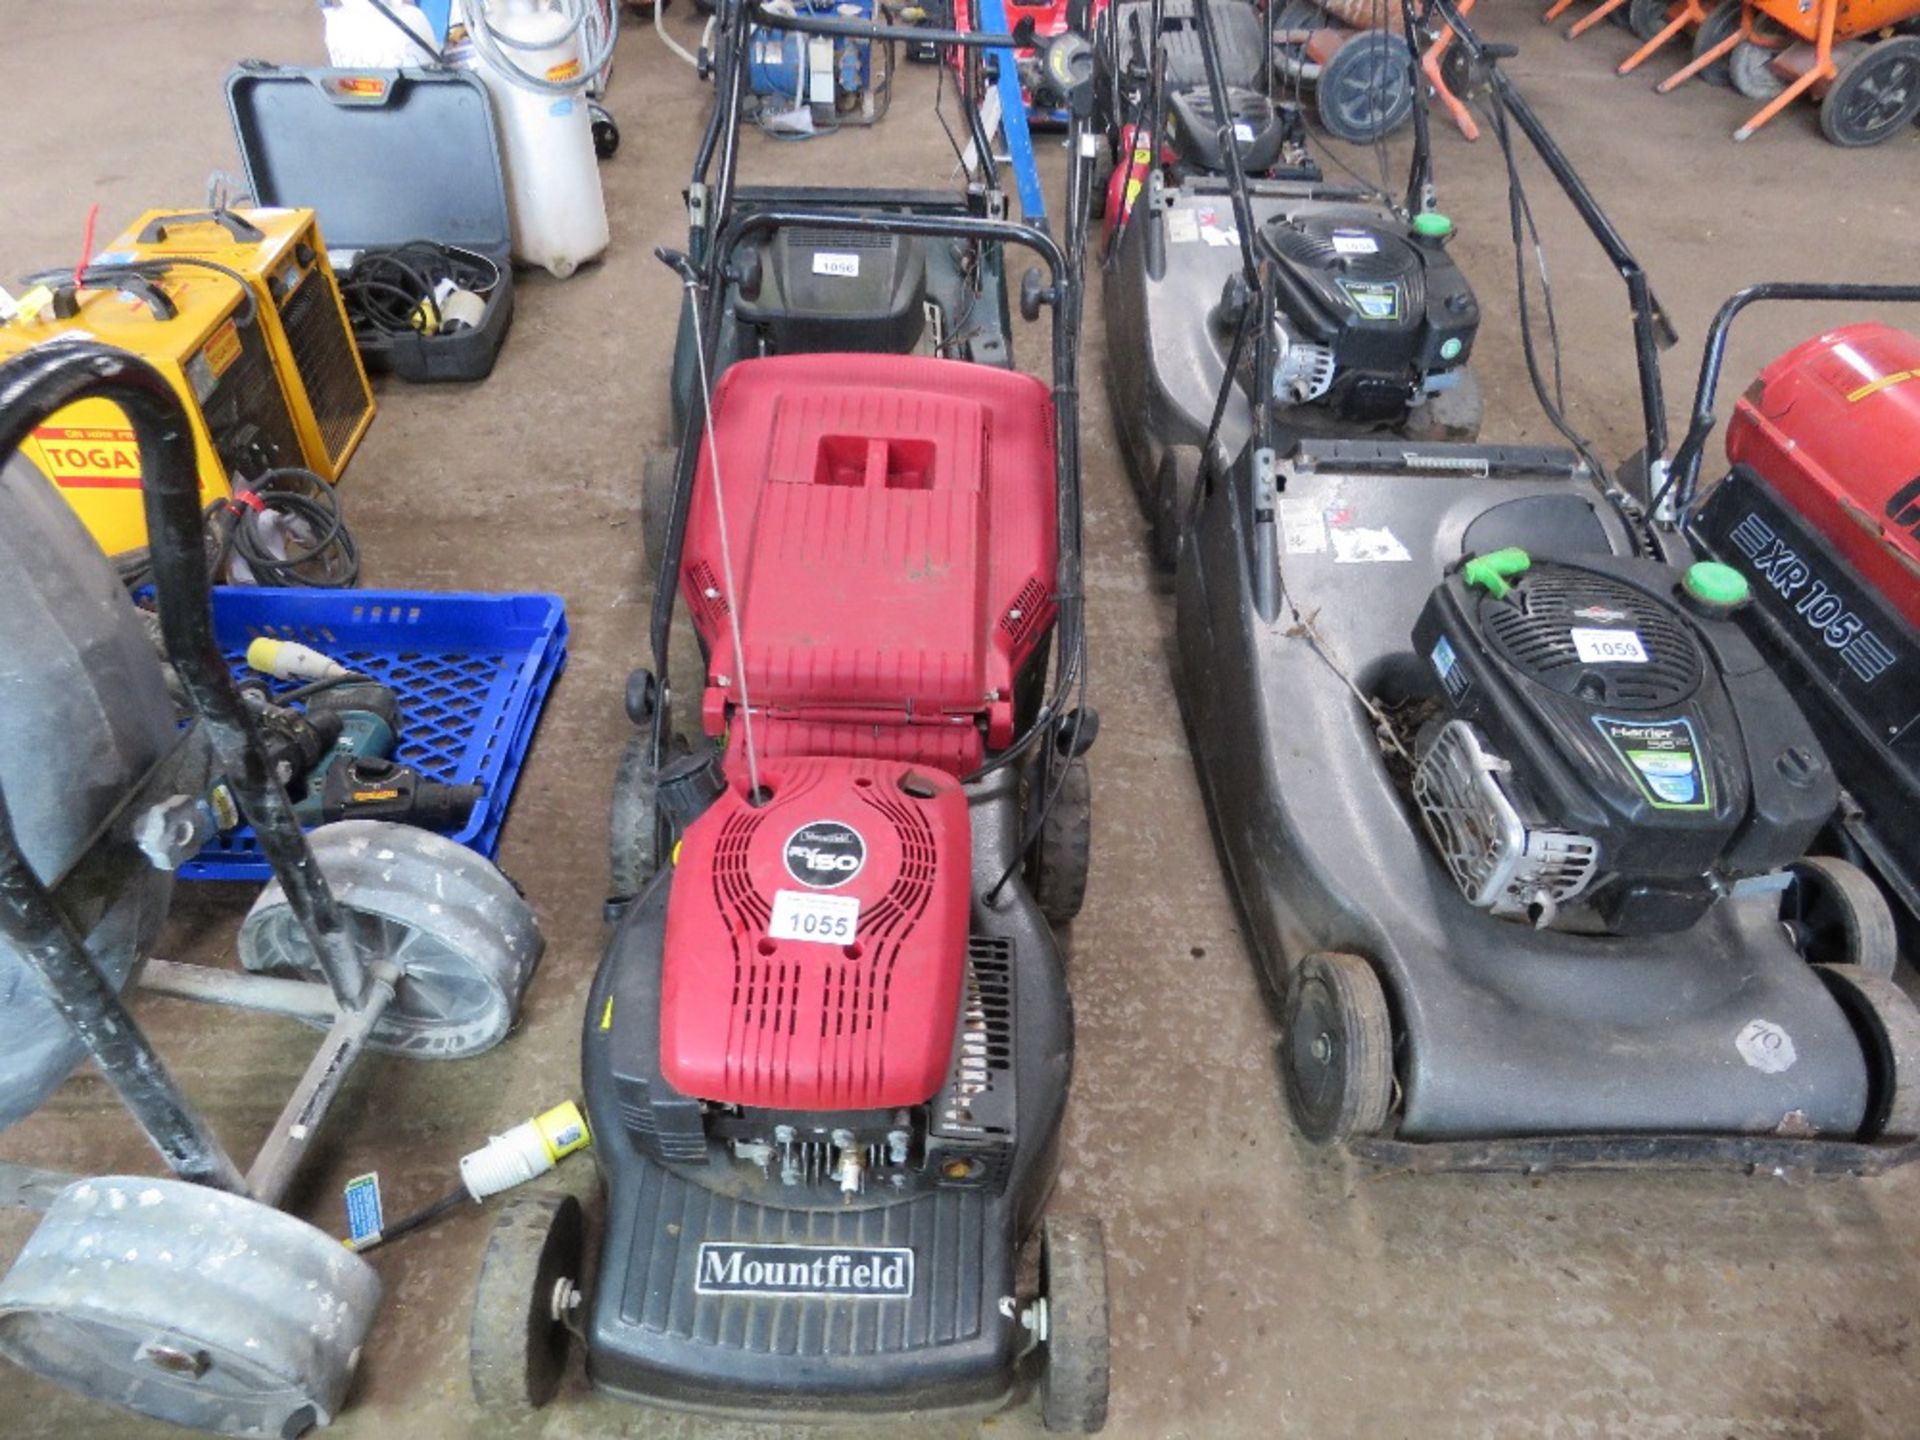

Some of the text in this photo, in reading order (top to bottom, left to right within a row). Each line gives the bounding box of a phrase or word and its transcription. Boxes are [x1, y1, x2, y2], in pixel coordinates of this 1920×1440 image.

[1753, 538, 1863, 648] XR 105
[1591, 642, 1639, 656] 1059
[1611, 727, 1673, 738] Harrier
[790, 912, 848, 936] 1055
[702, 1250, 905, 1289] Mountfield
